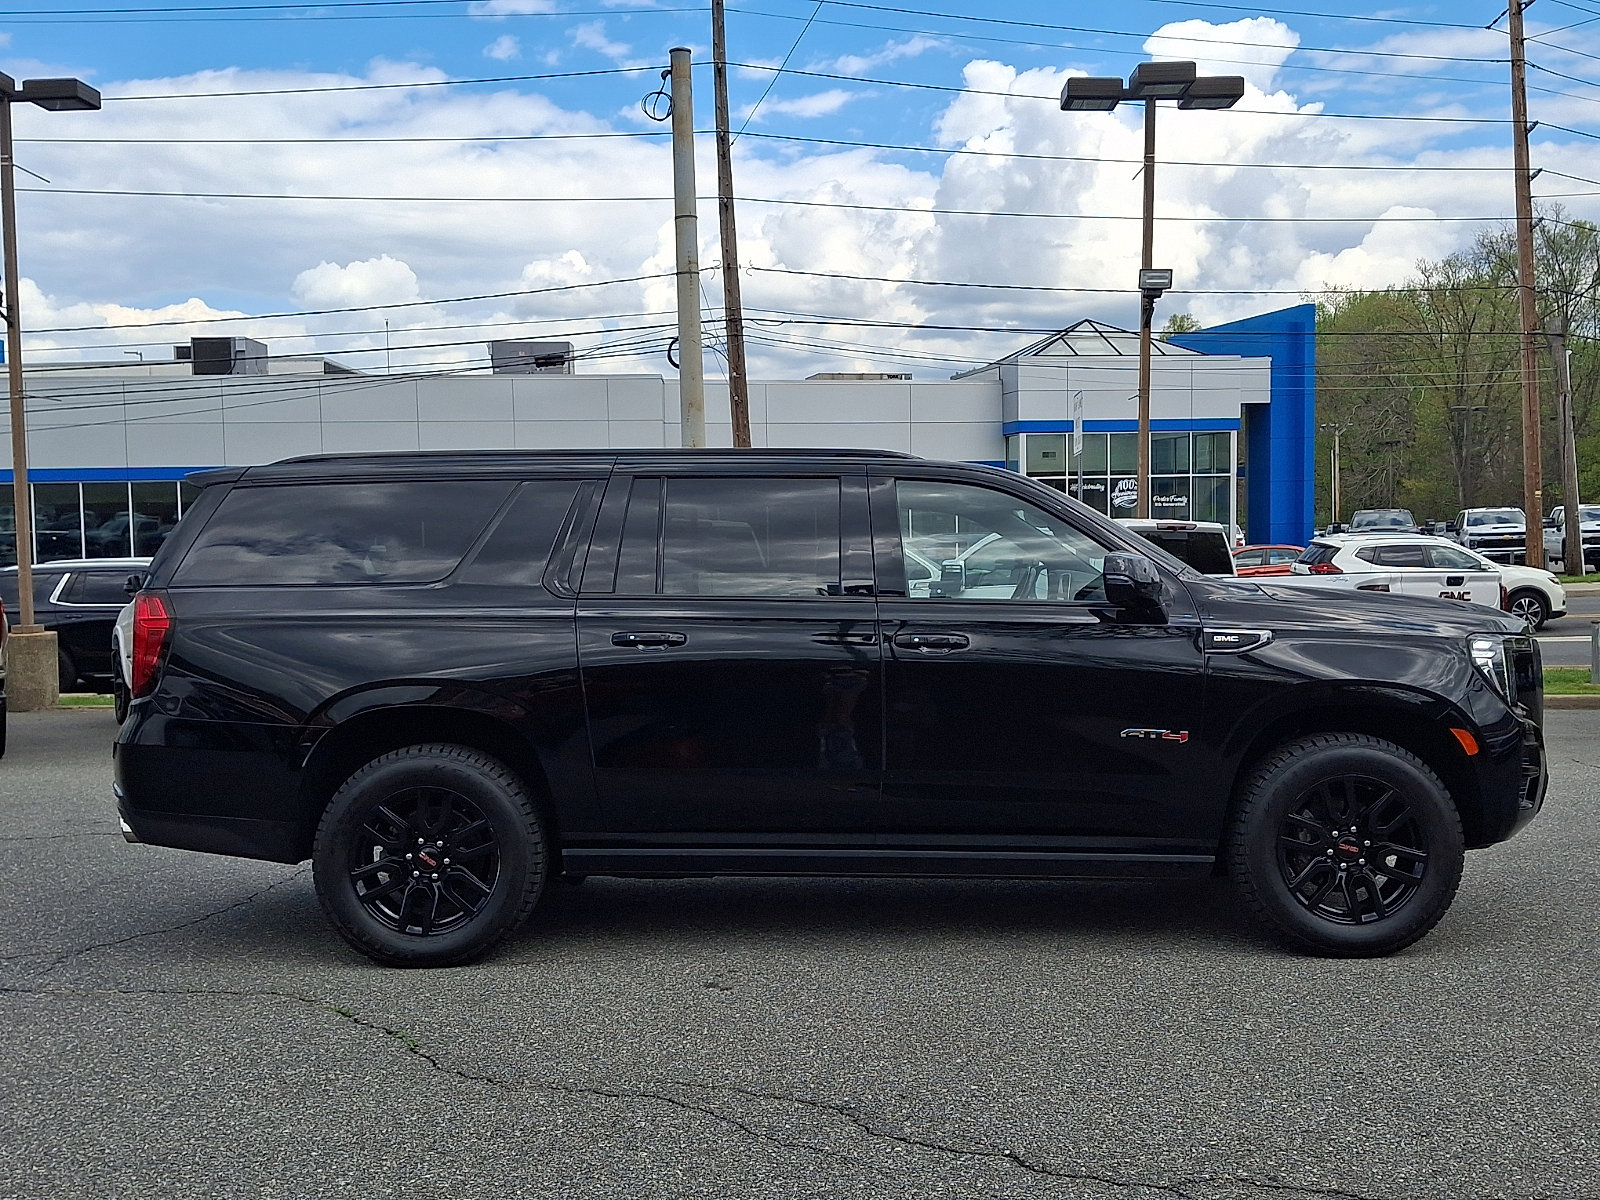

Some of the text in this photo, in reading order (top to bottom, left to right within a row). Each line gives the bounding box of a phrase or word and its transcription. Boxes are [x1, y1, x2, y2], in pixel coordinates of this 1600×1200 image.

[1170, 494, 1188, 503] Family
[1438, 591, 1471, 601] GMC
[1120, 728, 1188, 743] AT4
[1338, 843, 1359, 853] GMC
